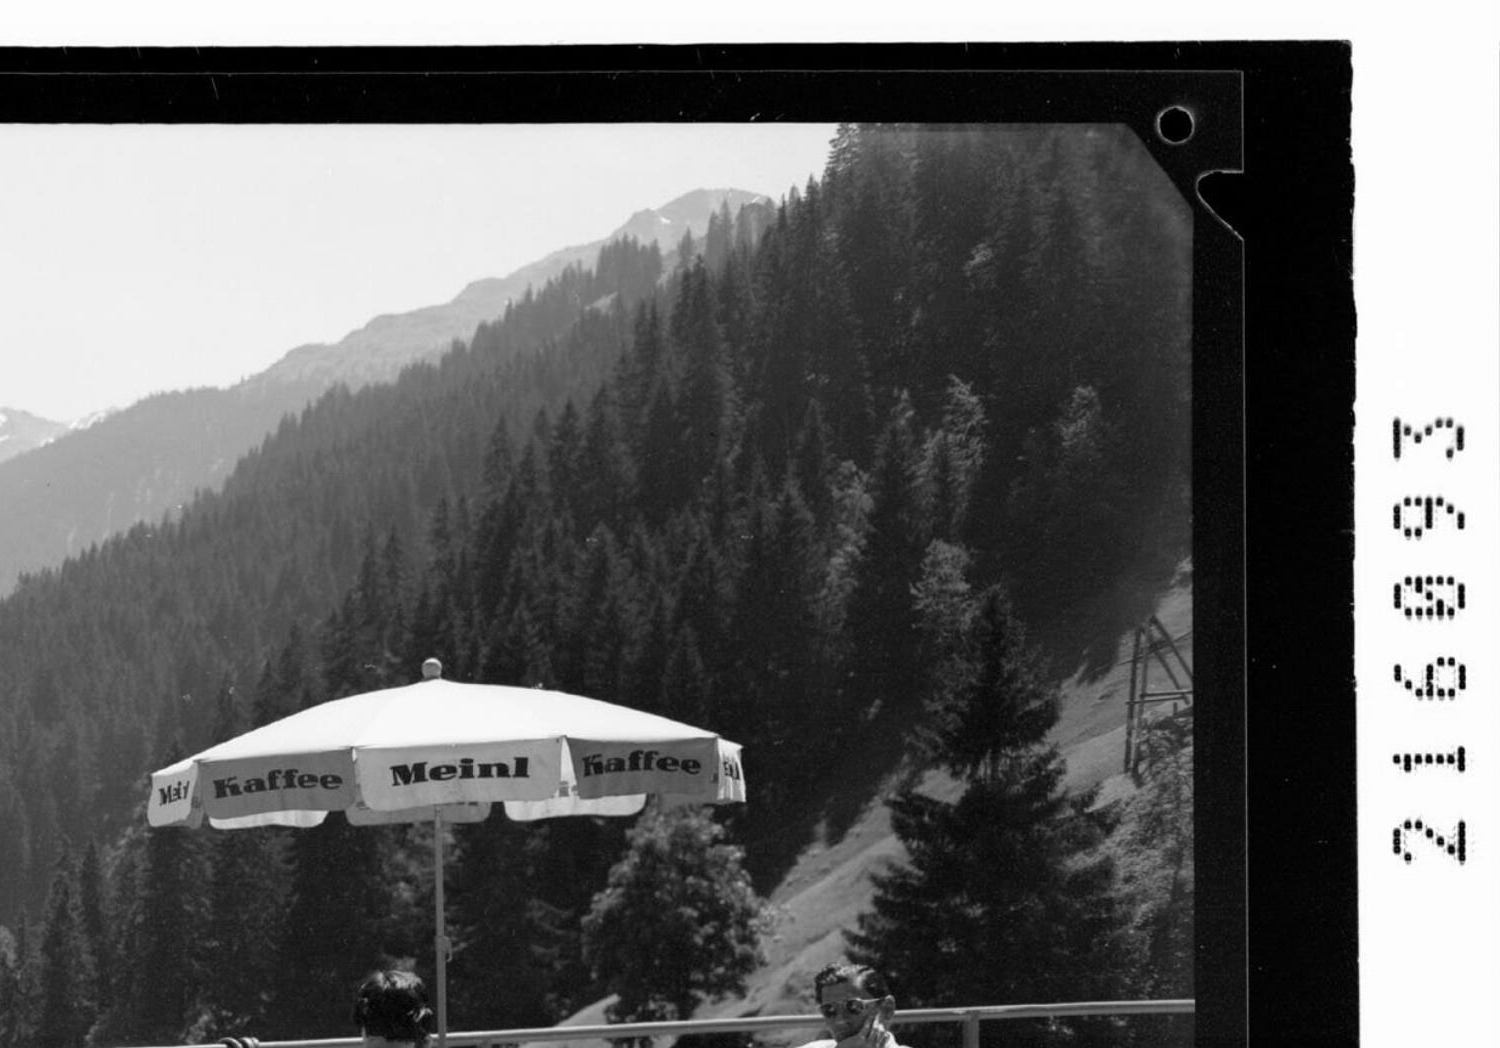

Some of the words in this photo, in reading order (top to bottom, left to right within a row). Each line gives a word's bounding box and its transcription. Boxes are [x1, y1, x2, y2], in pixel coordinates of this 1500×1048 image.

[389, 757, 530, 787] Meinl
[582, 750, 702, 777] Kaffee
[213, 768, 343, 799] Kaffee
